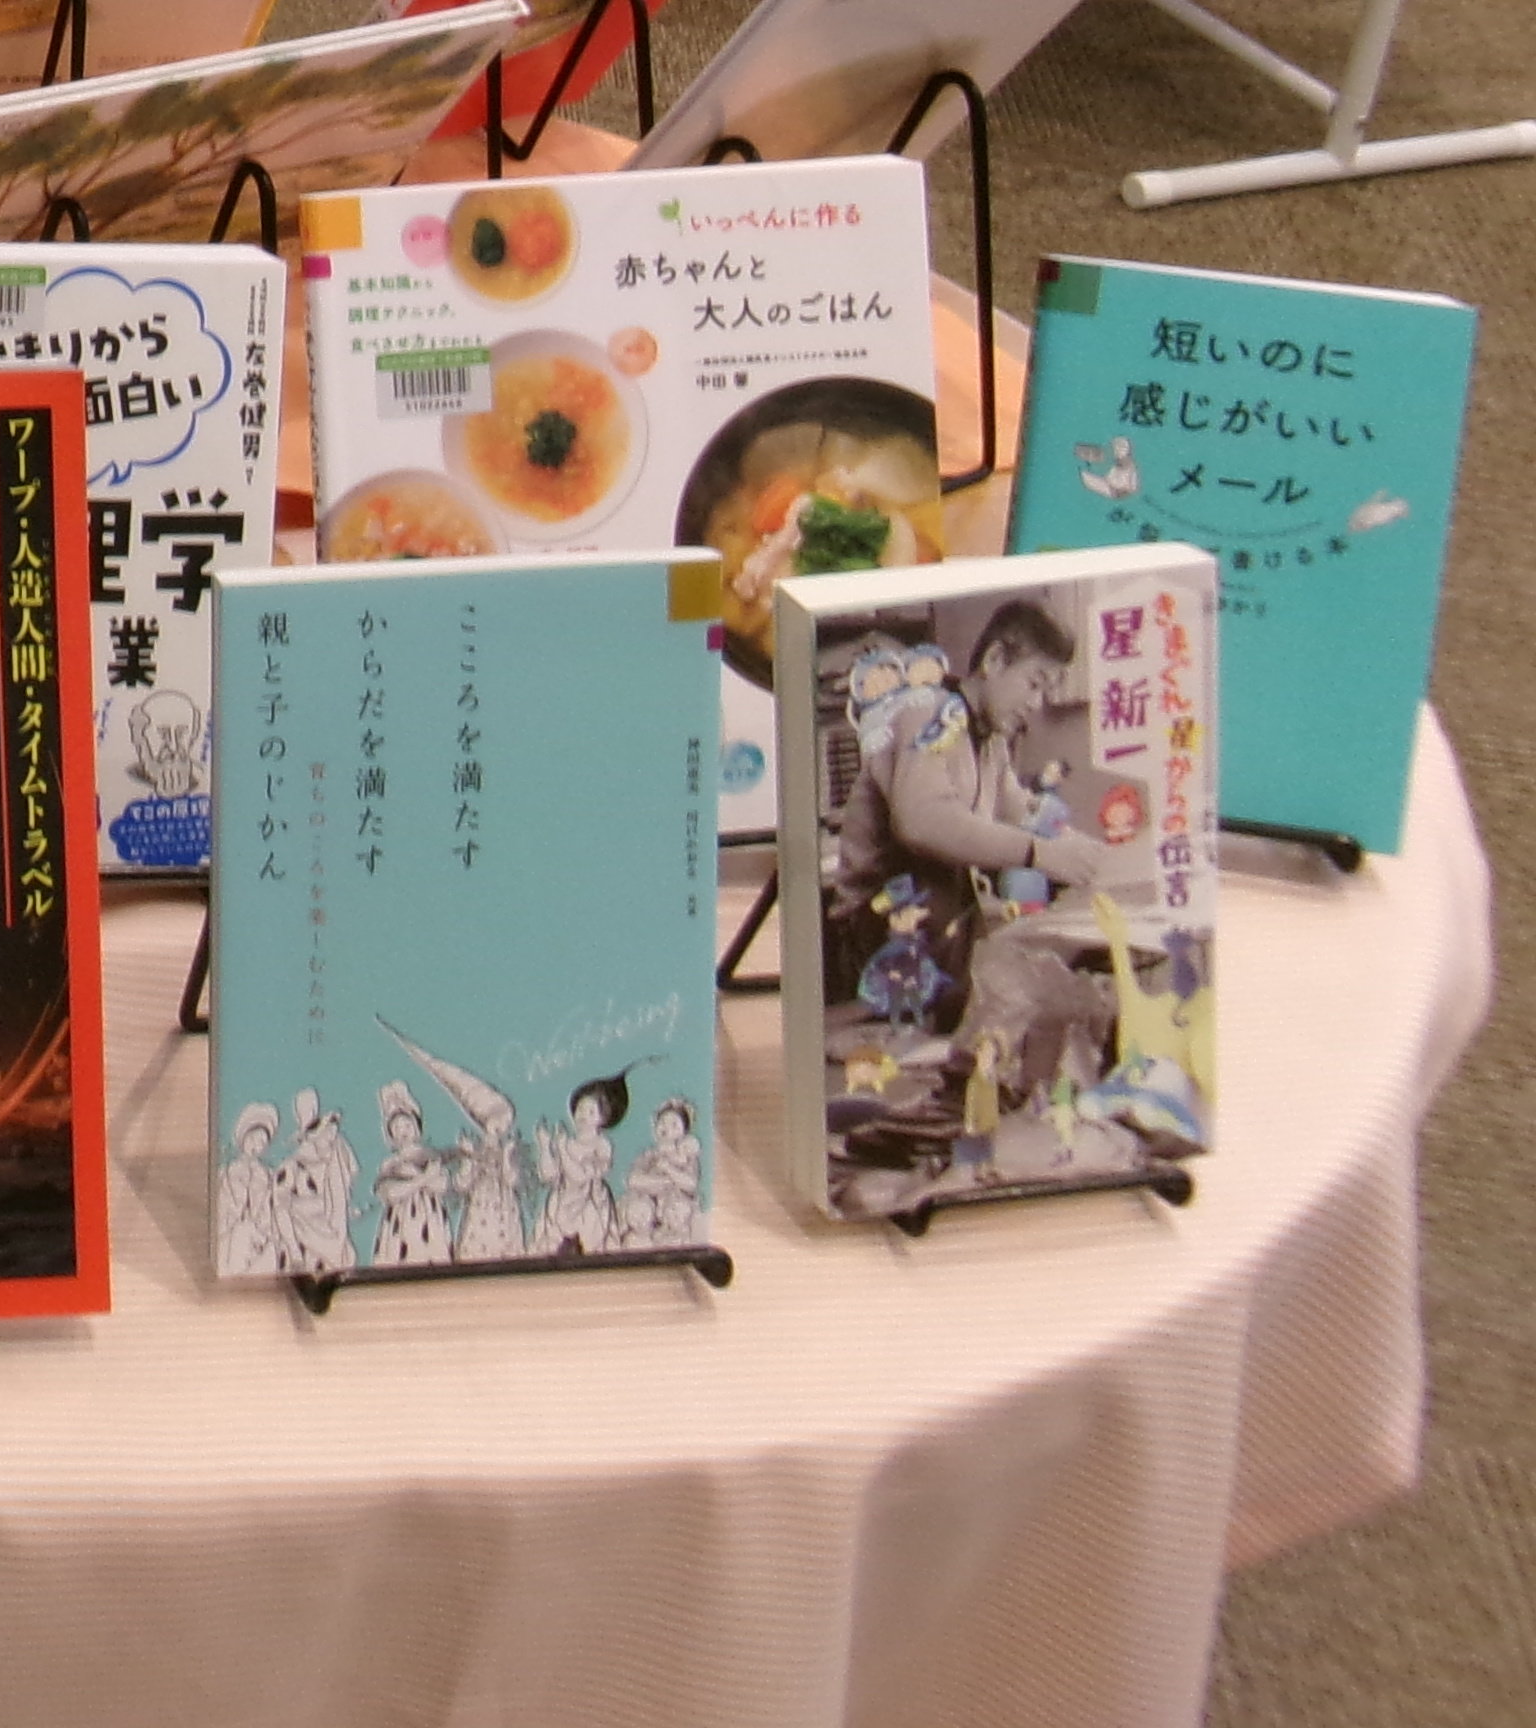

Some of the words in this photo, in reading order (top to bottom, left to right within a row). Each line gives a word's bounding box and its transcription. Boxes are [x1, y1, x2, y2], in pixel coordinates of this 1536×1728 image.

[689, 201, 862, 234] いっぺんに作る
[614, 251, 767, 288] 赤ちゃんと
[693, 289, 894, 332] 大人のごはん
[1150, 317, 1356, 380] 短いのに
[239, 342, 267, 460] 左巻健男
[1118, 383, 1377, 446] 感じがいい
[1169, 461, 1310, 506] メール
[8, 417, 55, 918] ワープ・人造人間・タイムトラベル
[1099, 606, 1150, 763] 星新一
[256, 611, 291, 882] 親と子のじかん
[355, 609, 388, 876] からだを満たす
[452, 602, 484, 870] こころを満たす
